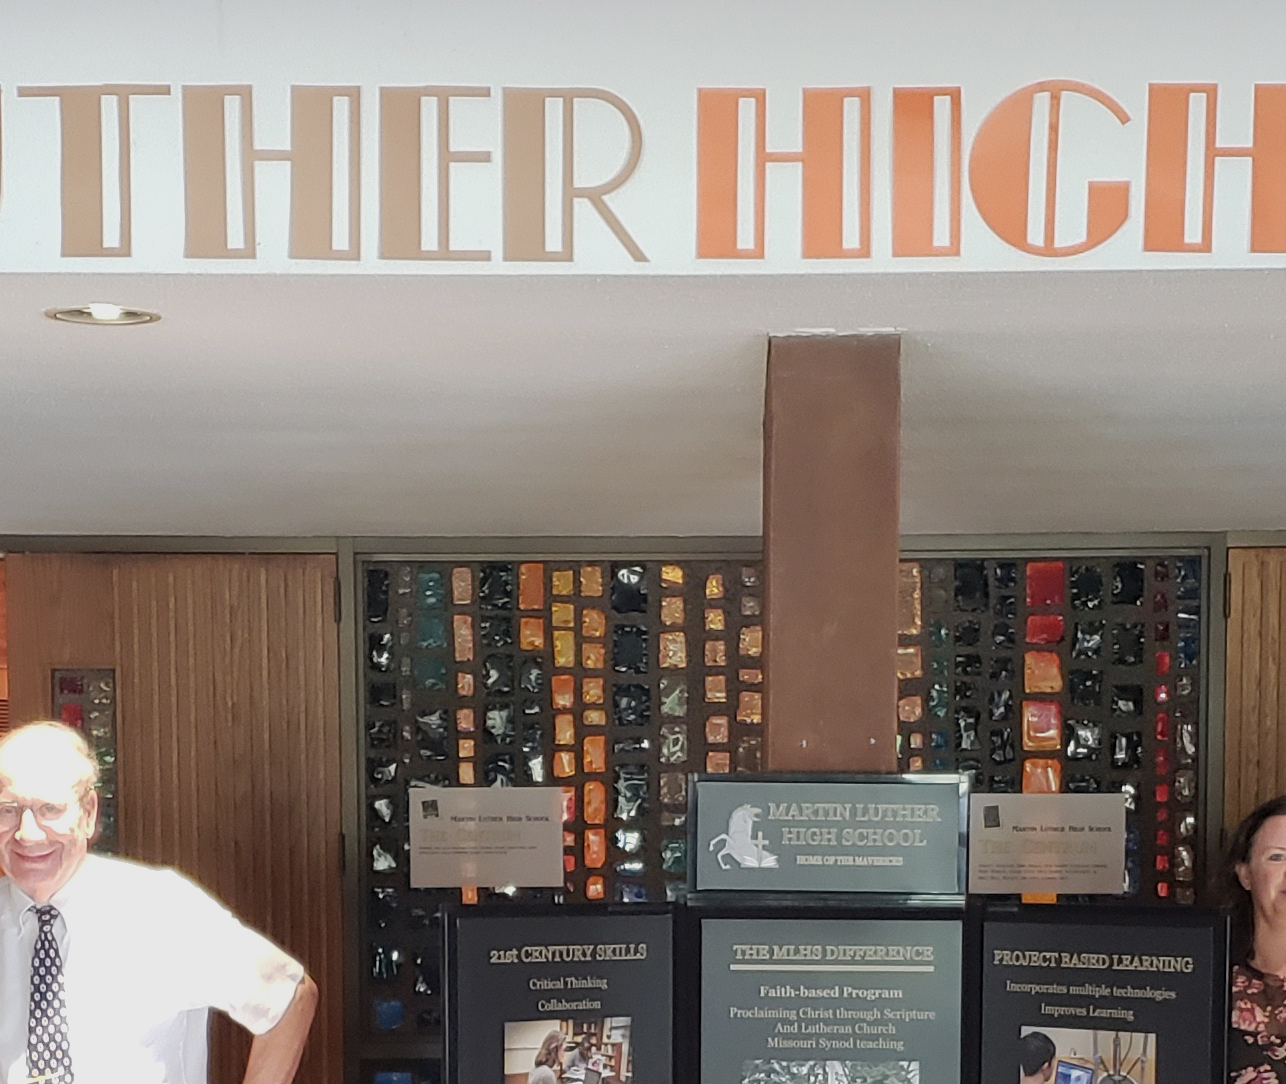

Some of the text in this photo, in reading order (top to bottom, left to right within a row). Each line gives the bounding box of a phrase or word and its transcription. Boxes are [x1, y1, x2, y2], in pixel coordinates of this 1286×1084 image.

[767, 802, 942, 822] MARTIN LUTHER
[781, 827, 927, 847] HIGH SCHOOL
[796, 855, 823, 865] HOME
[824, 855, 836, 865] OF
[836, 855, 855, 865] THE
[489, 943, 647, 963] 21st CENTURY SKILLS
[733, 945, 934, 961] THE MLHS DIFFERENCE
[993, 950, 1194, 973] PROJECT BASED LEARNING
[529, 976, 608, 991] Critical Thinking
[1006, 980, 1176, 1001] Incorporates multiple technologies
[759, 985, 903, 1000] Faith-based Program
[538, 998, 601, 1011] Collaboration
[1041, 1002, 1134, 1021] Improves Learning
[729, 1007, 936, 1022] Proclaiming Christ through Scripture
[774, 1022, 896, 1034] And Lutheran Church
[767, 1037, 904, 1050] Missouri Synod teaching
